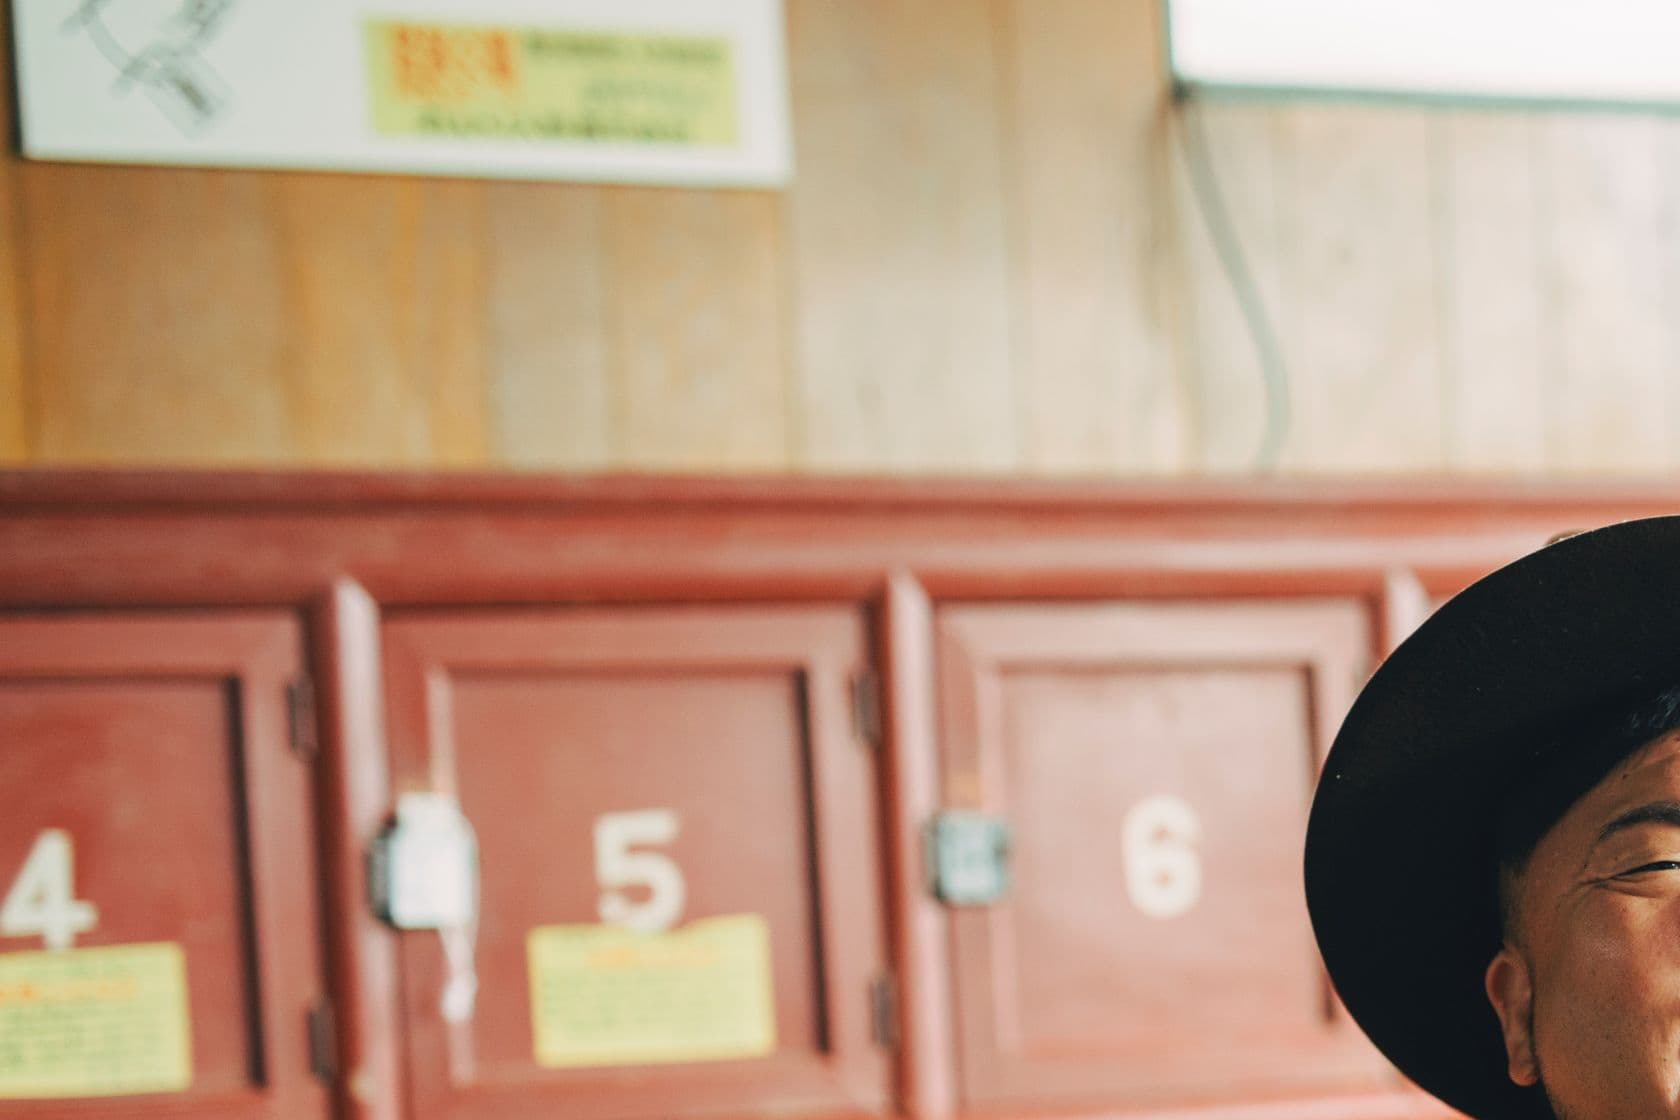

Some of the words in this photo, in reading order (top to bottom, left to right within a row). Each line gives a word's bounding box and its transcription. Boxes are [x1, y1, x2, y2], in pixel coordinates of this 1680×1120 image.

[0, 826, 98, 951] 4
[594, 806, 688, 932] 5
[1121, 795, 1203, 918] 6
